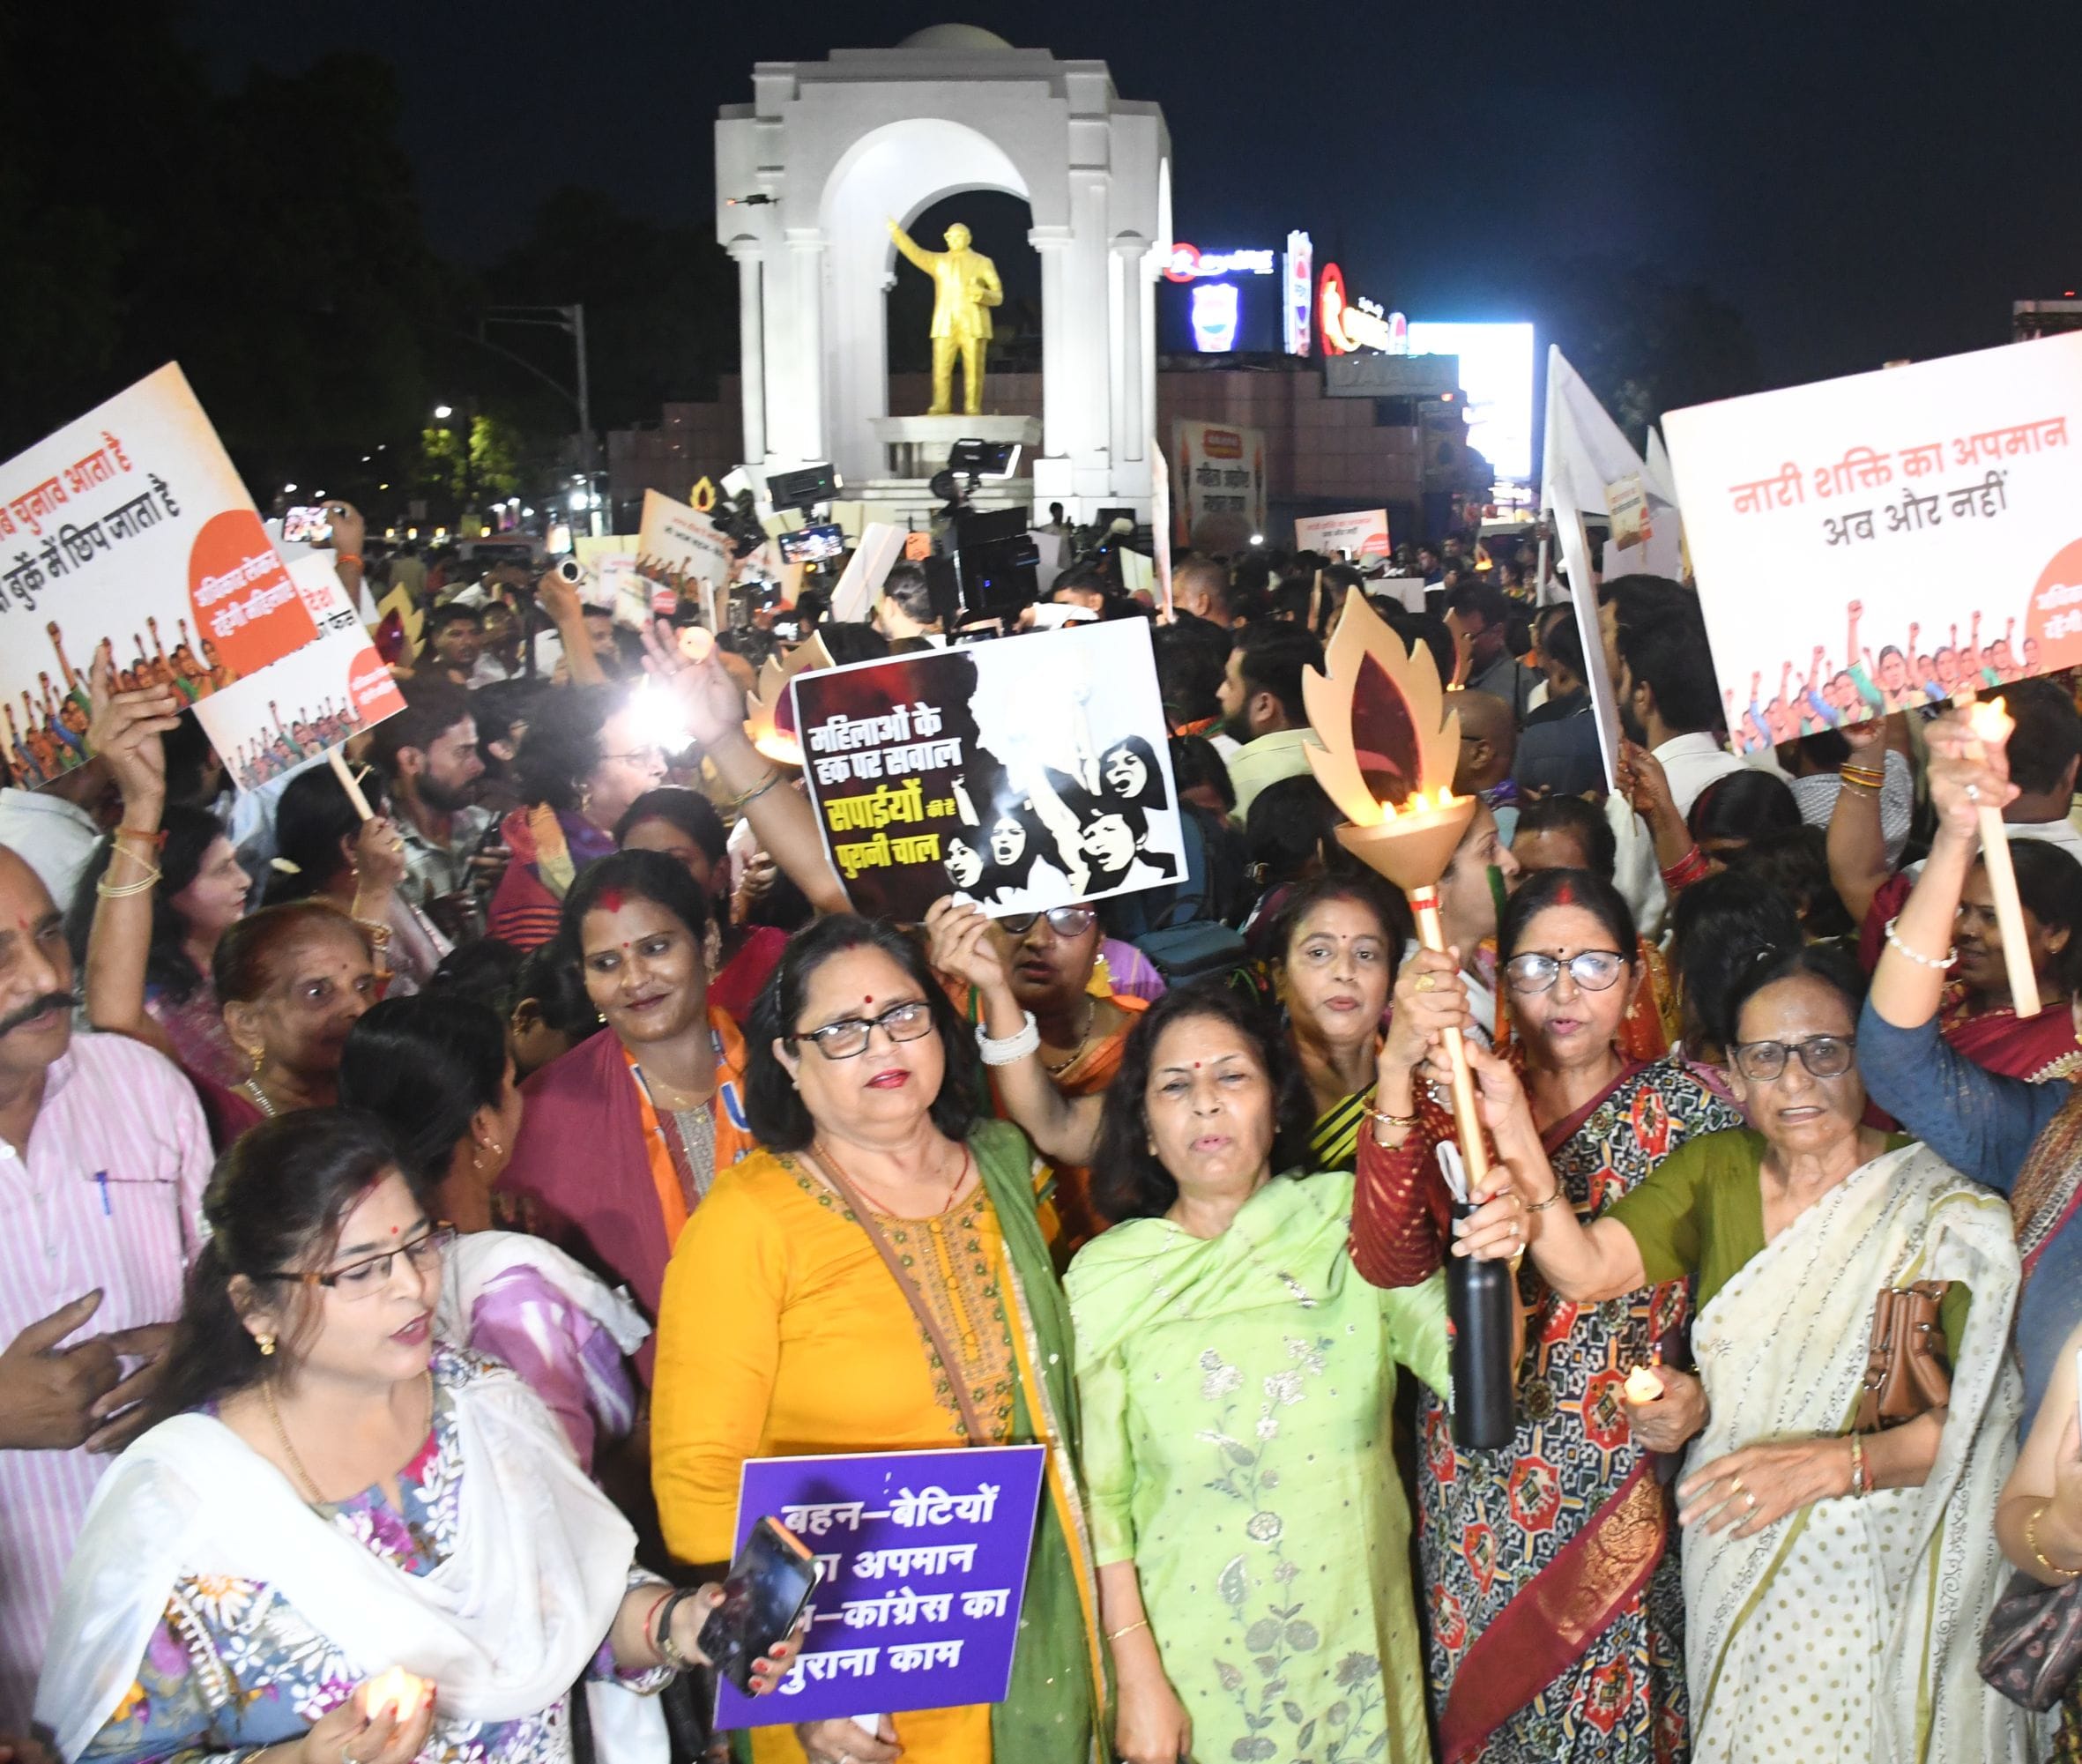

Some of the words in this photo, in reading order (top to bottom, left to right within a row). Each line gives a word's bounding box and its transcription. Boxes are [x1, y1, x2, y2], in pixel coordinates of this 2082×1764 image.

[9, 476, 70, 536] चुनाव
[63, 449, 116, 494] आता
[100, 430, 133, 473] है
[1729, 461, 1804, 514] नारी
[1813, 446, 1892, 498] शक्ति
[1898, 443, 1945, 478] का
[1953, 415, 2069, 465] अपमान
[40, 535, 70, 577] में
[58, 524, 113, 569] छिप
[102, 492, 163, 539] जाता
[147, 473, 181, 517] है
[1885, 488, 1941, 532] और
[1947, 470, 2009, 517] नहीं
[807, 704, 911, 753] महिलाओं
[911, 702, 942, 737] के
[814, 755, 851, 785] हक
[850, 749, 883, 779] पर
[882, 737, 963, 776] सवाल
[824, 778, 925, 831] सपाईयों
[834, 832, 892, 879] पुरानी
[890, 833, 941, 865] चाल
[852, 1543, 978, 1579] अपमान
[961, 1588, 1011, 1619] का
[887, 1640, 965, 1673] काम
